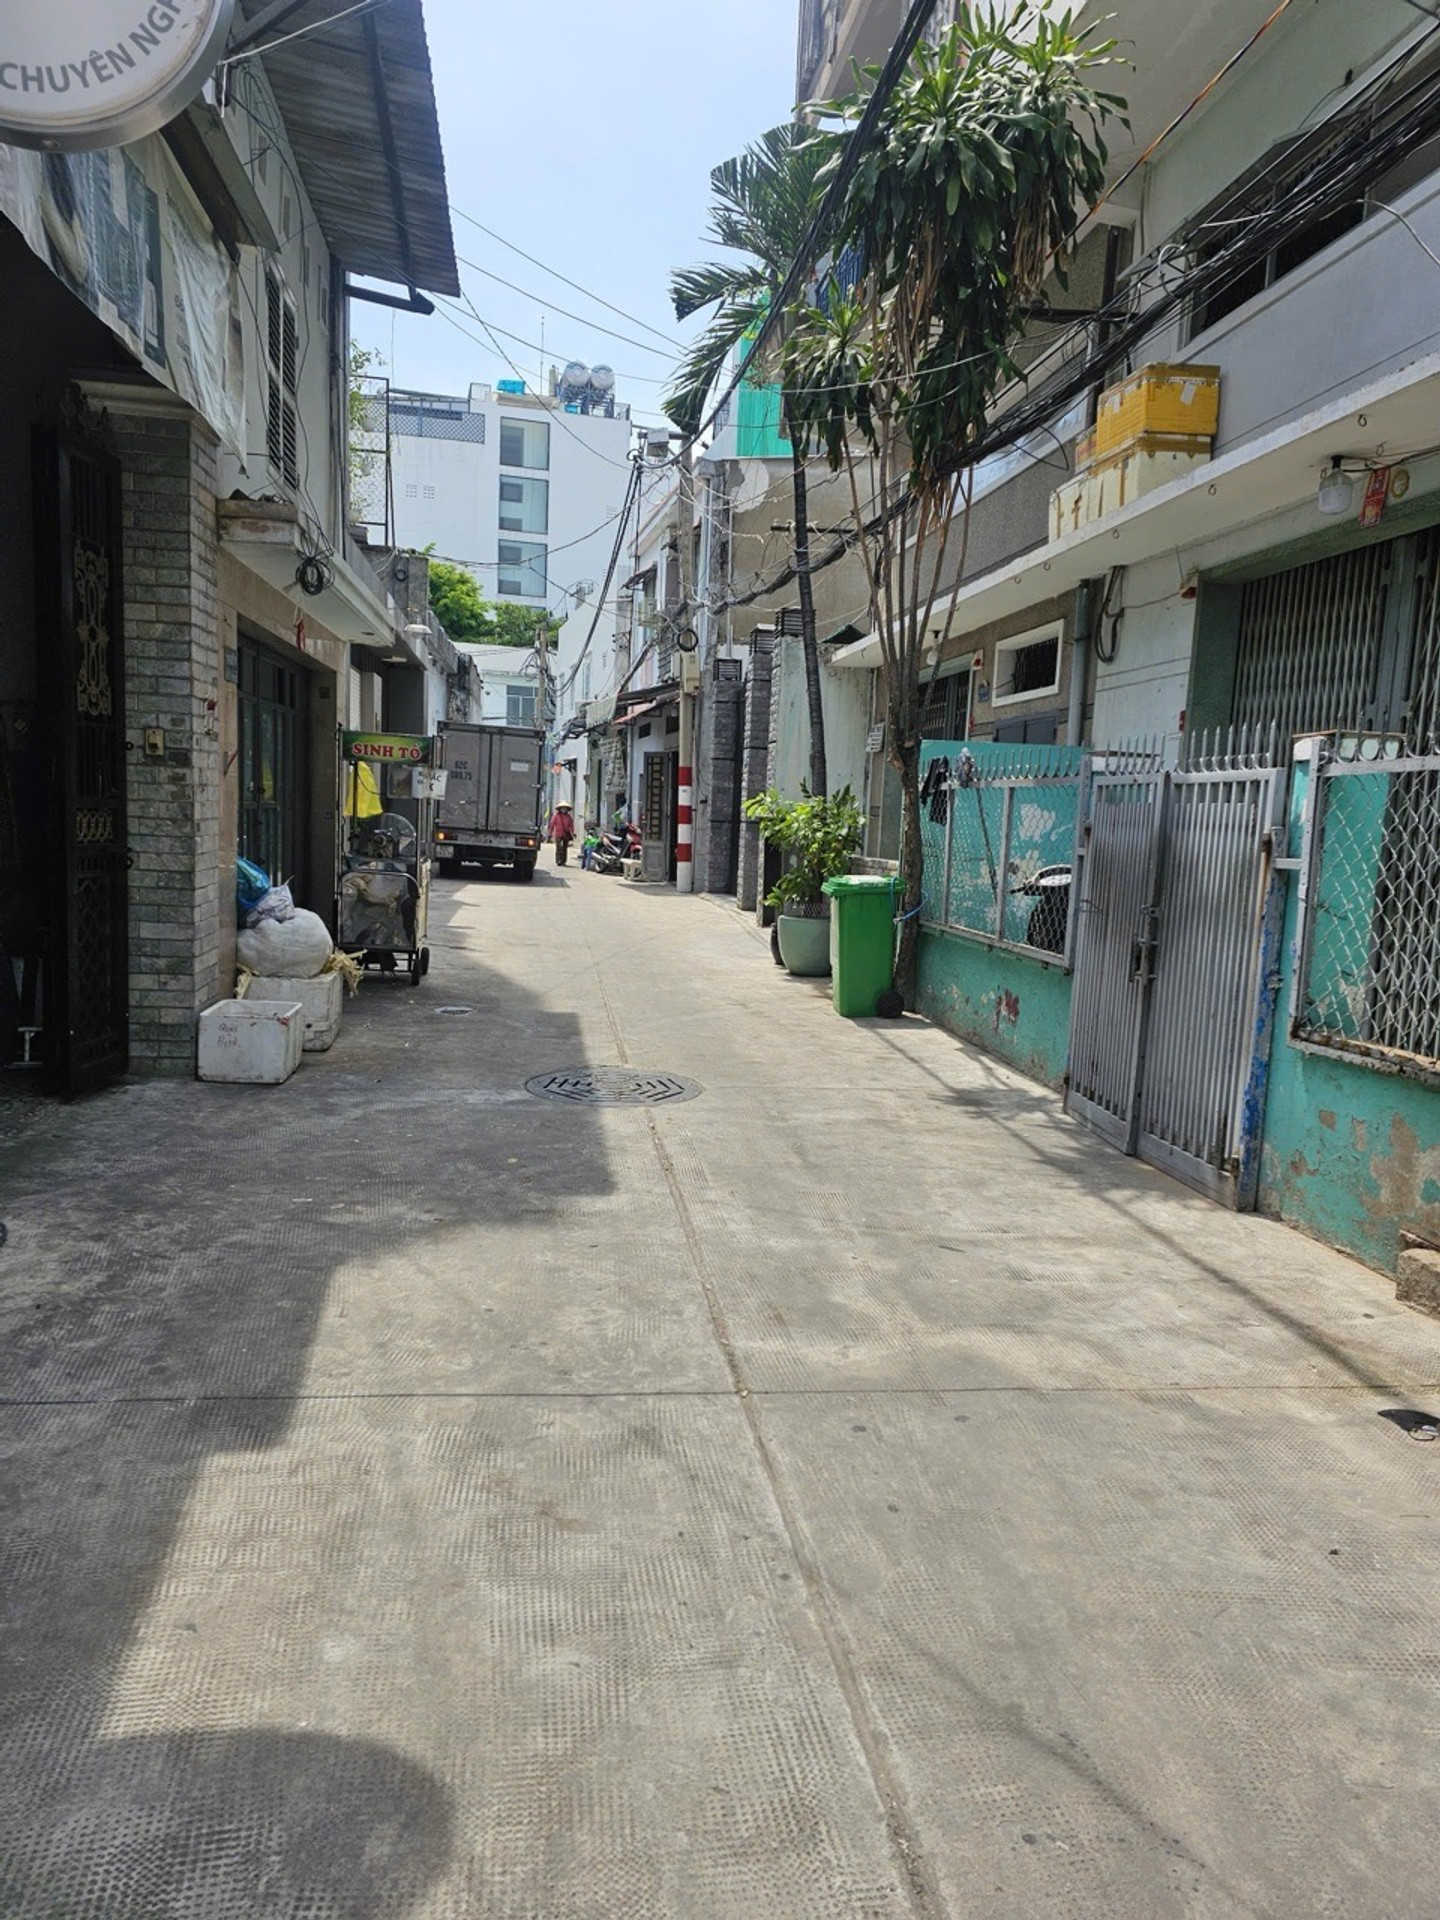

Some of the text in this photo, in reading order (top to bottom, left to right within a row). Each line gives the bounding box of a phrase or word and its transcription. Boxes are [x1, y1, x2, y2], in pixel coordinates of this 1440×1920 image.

[0, 42, 137, 94] CHUYÊN
[352, 741, 422, 760] SINH TỐ
